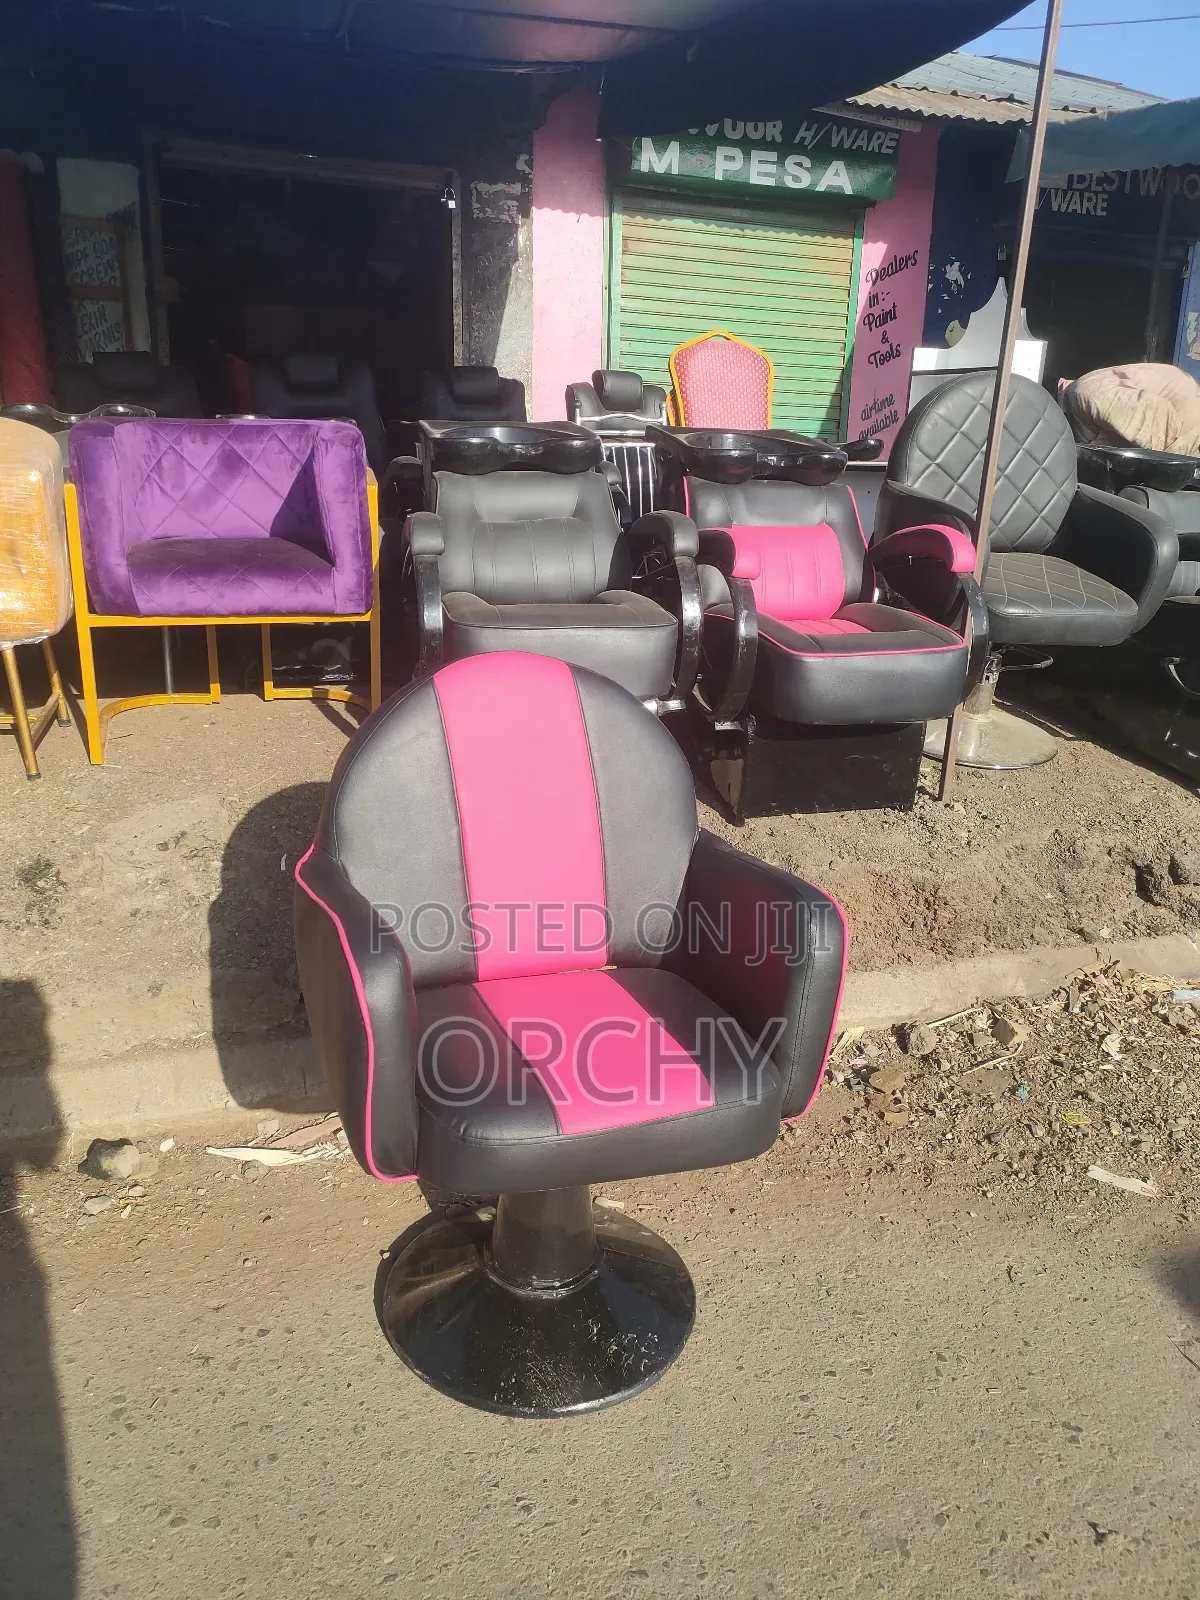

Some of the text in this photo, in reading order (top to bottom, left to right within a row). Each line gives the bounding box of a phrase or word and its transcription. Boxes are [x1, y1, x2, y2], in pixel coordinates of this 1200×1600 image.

[793, 119, 900, 155] H/WARE
[714, 145, 853, 195] PESA
[865, 249, 919, 287] Dealers
[862, 301, 898, 332] Paint
[880, 329, 890, 345] &
[867, 342, 902, 369] Tools
[860, 393, 896, 422] airtime
[858, 409, 900, 441] available
